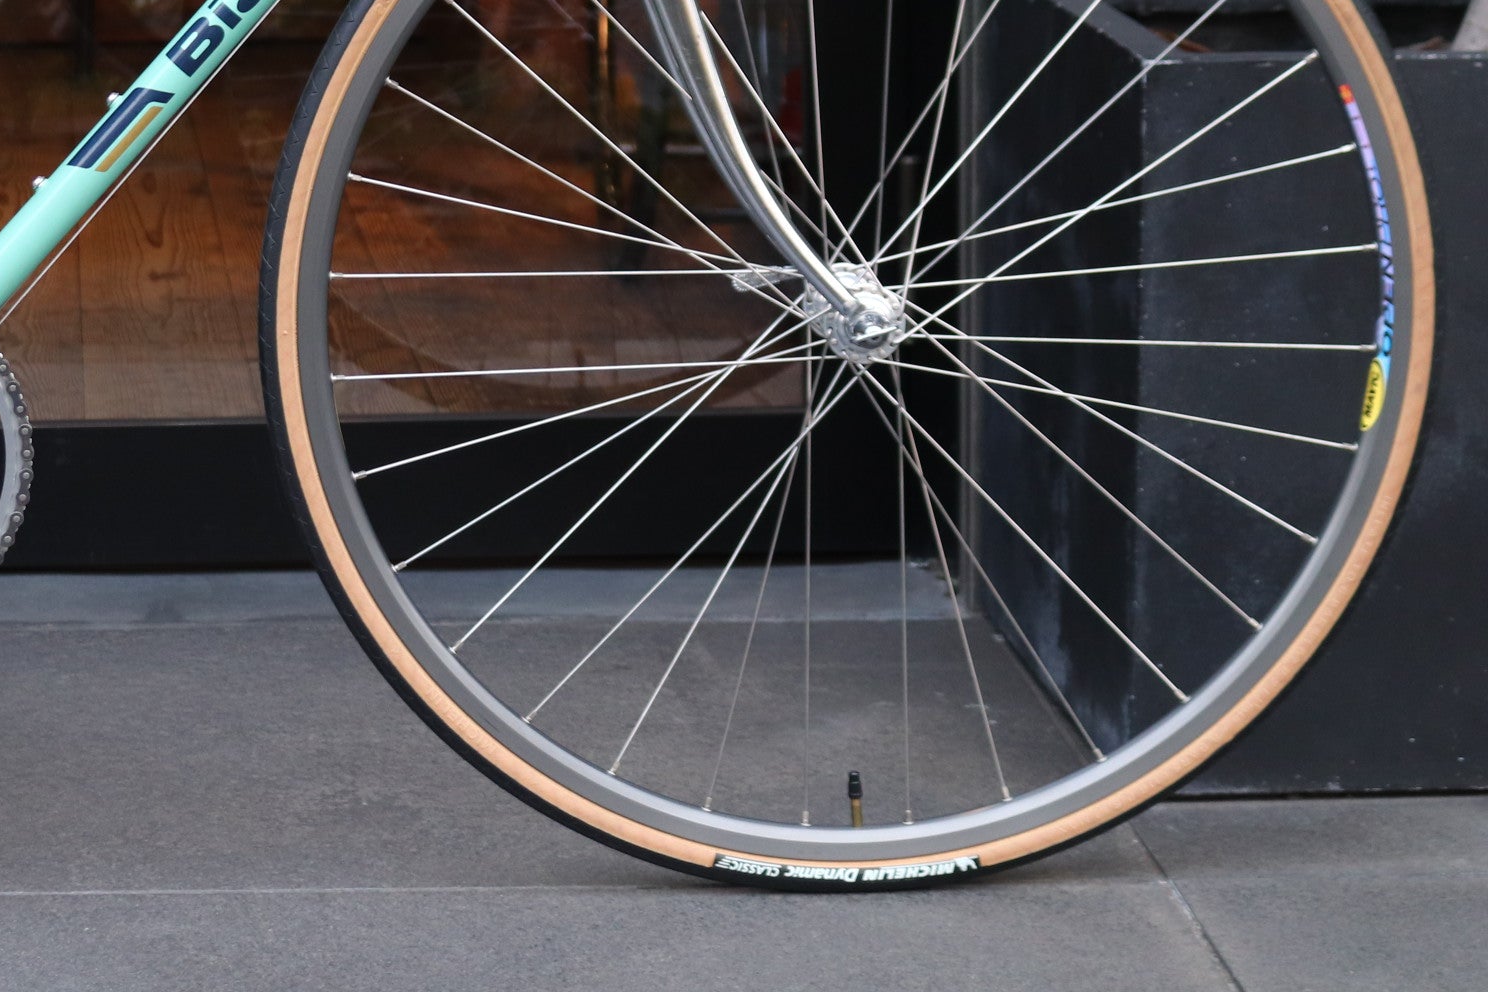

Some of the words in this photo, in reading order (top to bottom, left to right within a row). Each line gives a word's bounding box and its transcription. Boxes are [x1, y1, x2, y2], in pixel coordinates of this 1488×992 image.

[725, 858, 781, 876] CLASSIC
[784, 865, 859, 883] Dynamic
[862, 861, 956, 881] MICHELIN
